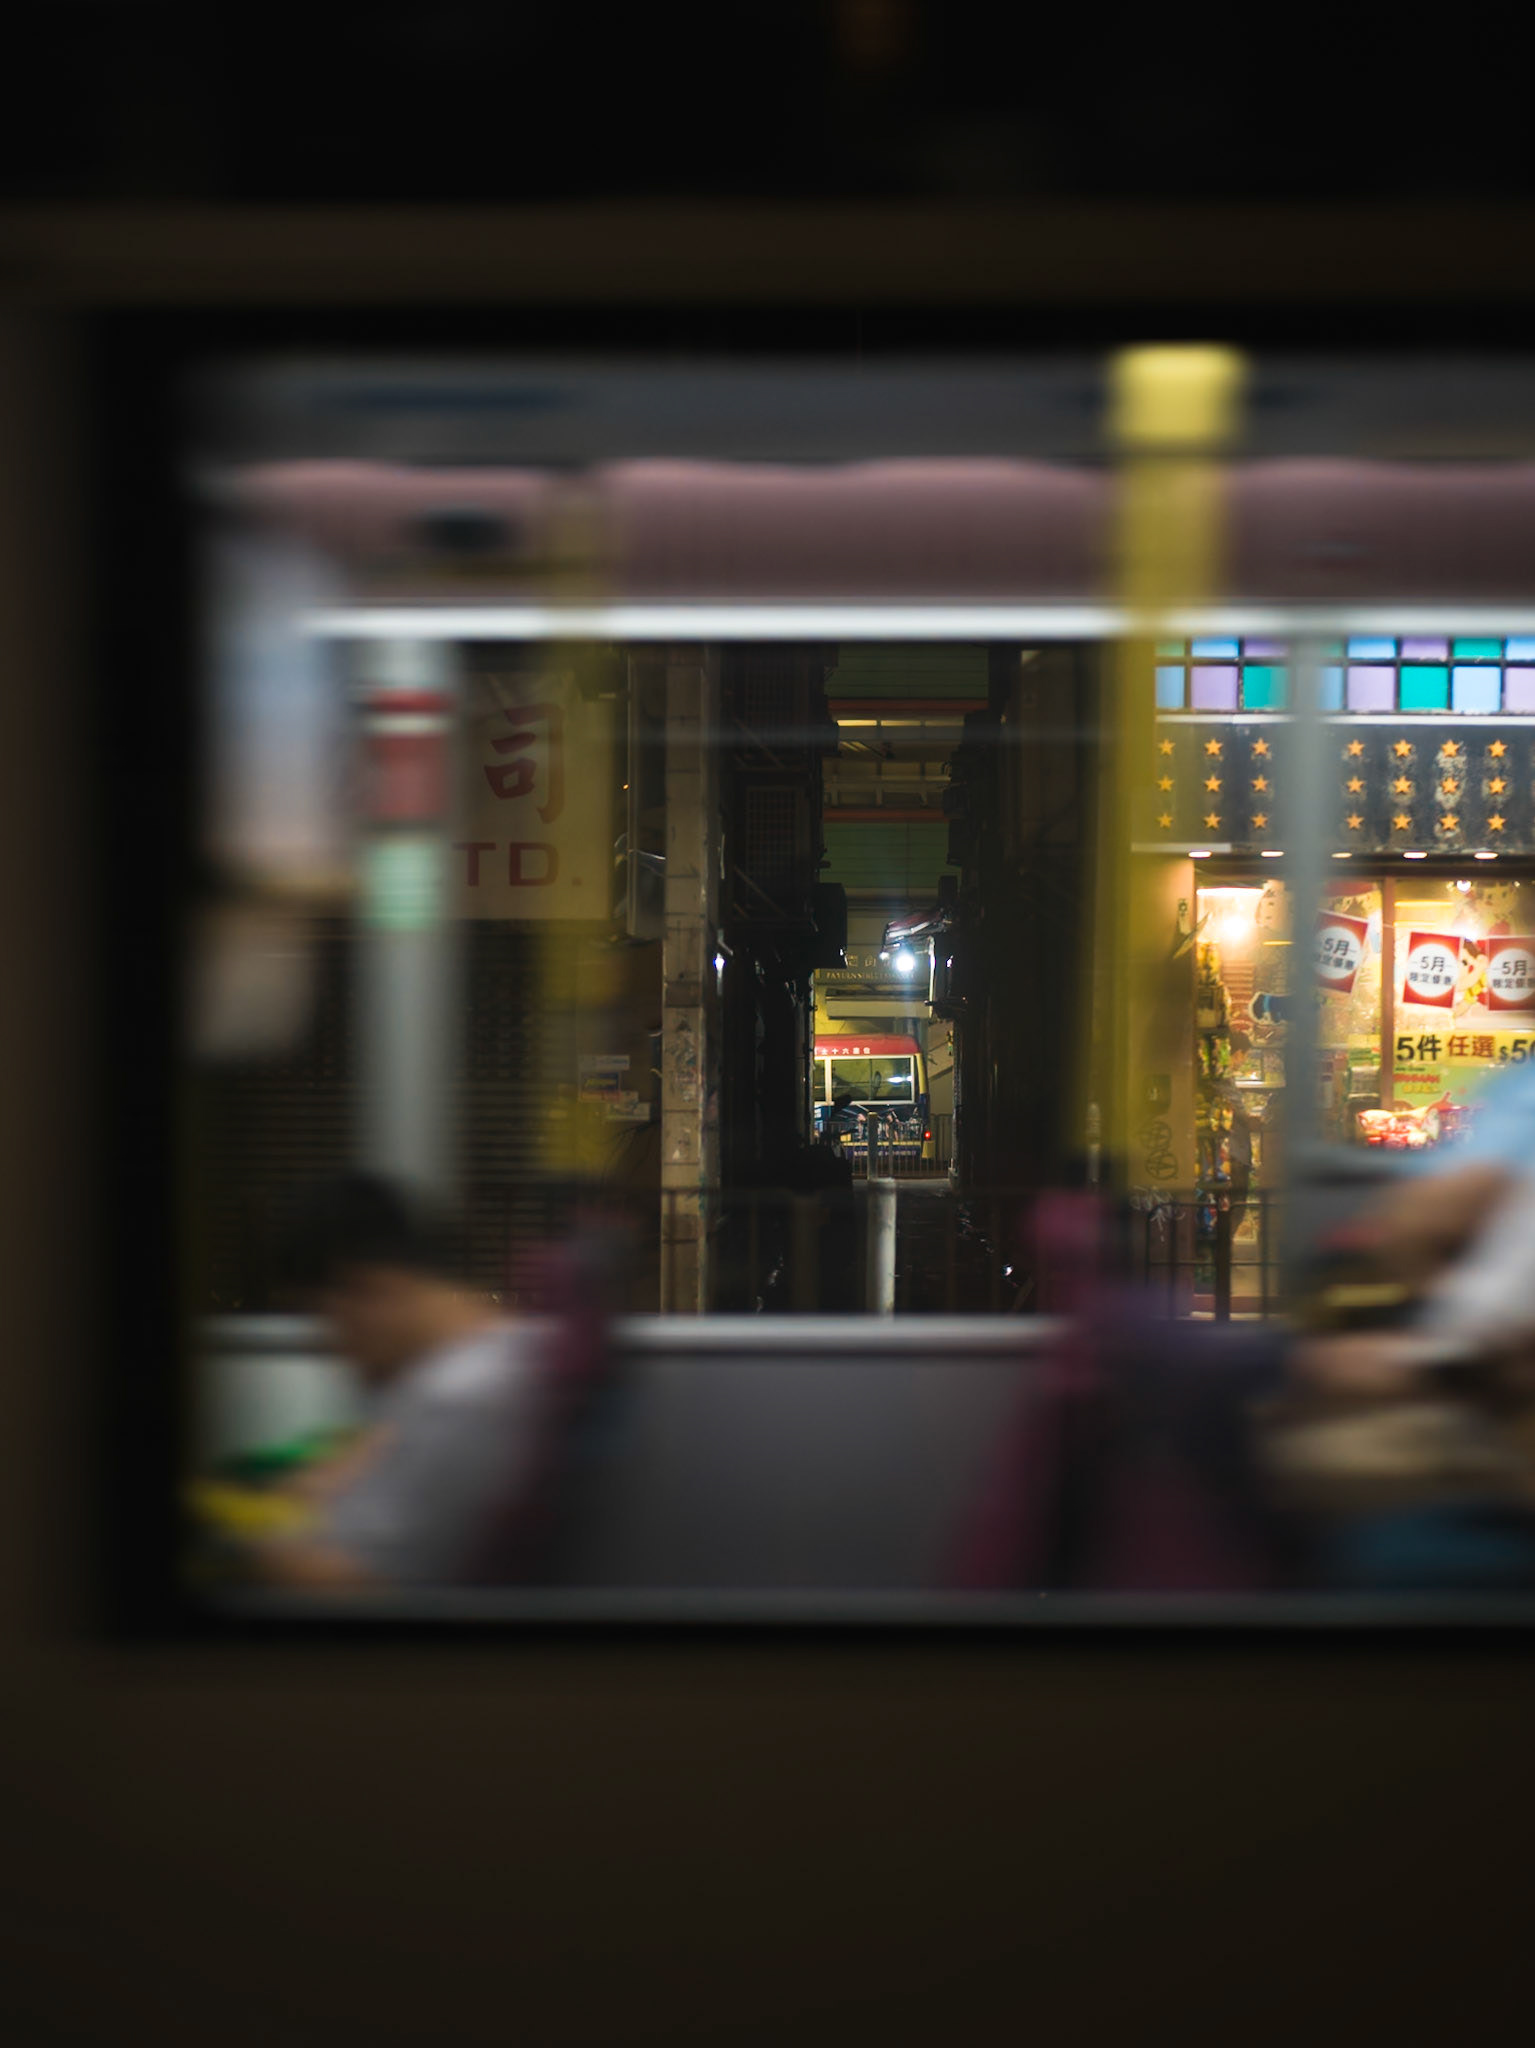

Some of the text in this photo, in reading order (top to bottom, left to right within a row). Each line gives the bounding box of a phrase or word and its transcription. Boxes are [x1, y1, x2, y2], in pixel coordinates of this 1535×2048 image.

[483, 702, 566, 824] 司
[452, 842, 583, 887] TD.
[1323, 937, 1350, 956] 5月
[1315, 953, 1355, 971] 定優惠
[1420, 955, 1445, 973] 5月
[1502, 960, 1528, 976] 5月
[1396, 1033, 1442, 1062] 5件
[1447, 1034, 1496, 1058] 任選
